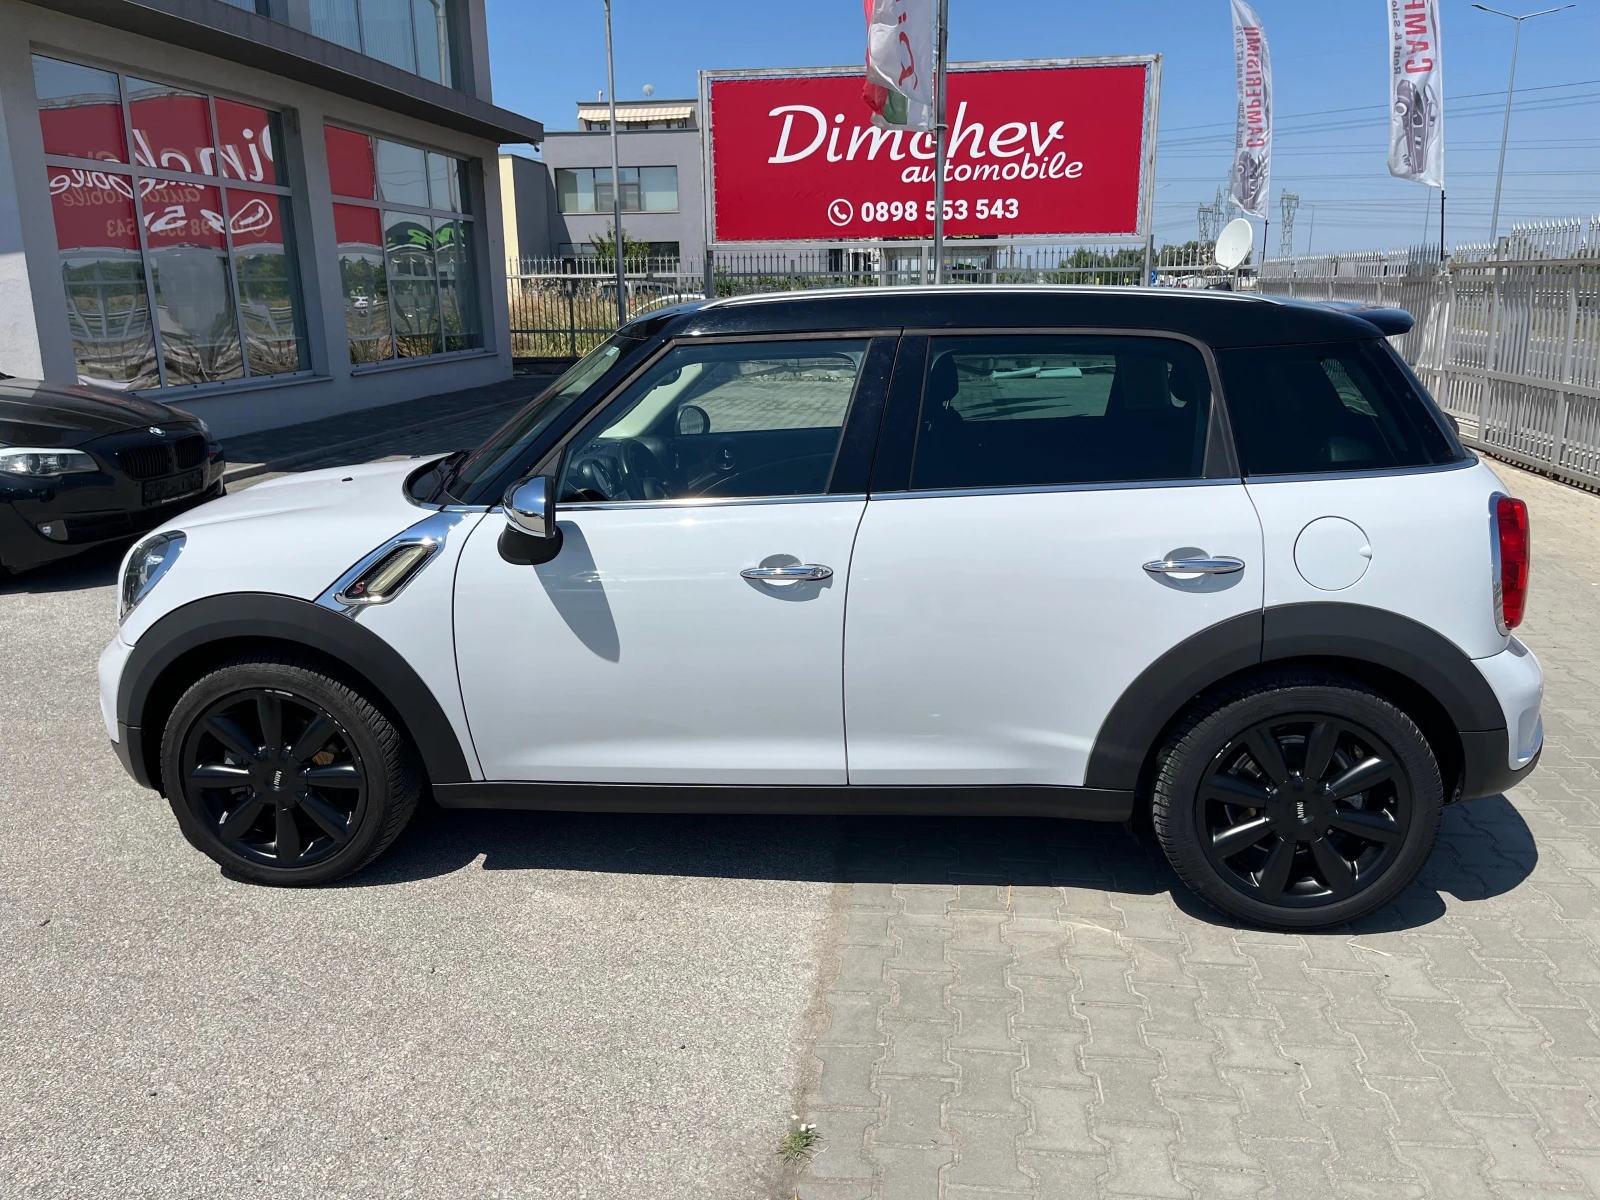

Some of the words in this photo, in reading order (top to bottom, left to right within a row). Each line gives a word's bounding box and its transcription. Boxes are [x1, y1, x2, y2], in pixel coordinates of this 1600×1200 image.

[768, 101, 1064, 163] Dimchev
[901, 151, 1083, 183] automobile
[861, 201, 918, 223] 0898
[925, 200, 968, 221] 553
[975, 198, 1019, 219] 543
[273, 770, 282, 786] MINI
[1296, 801, 1305, 819] MINI
